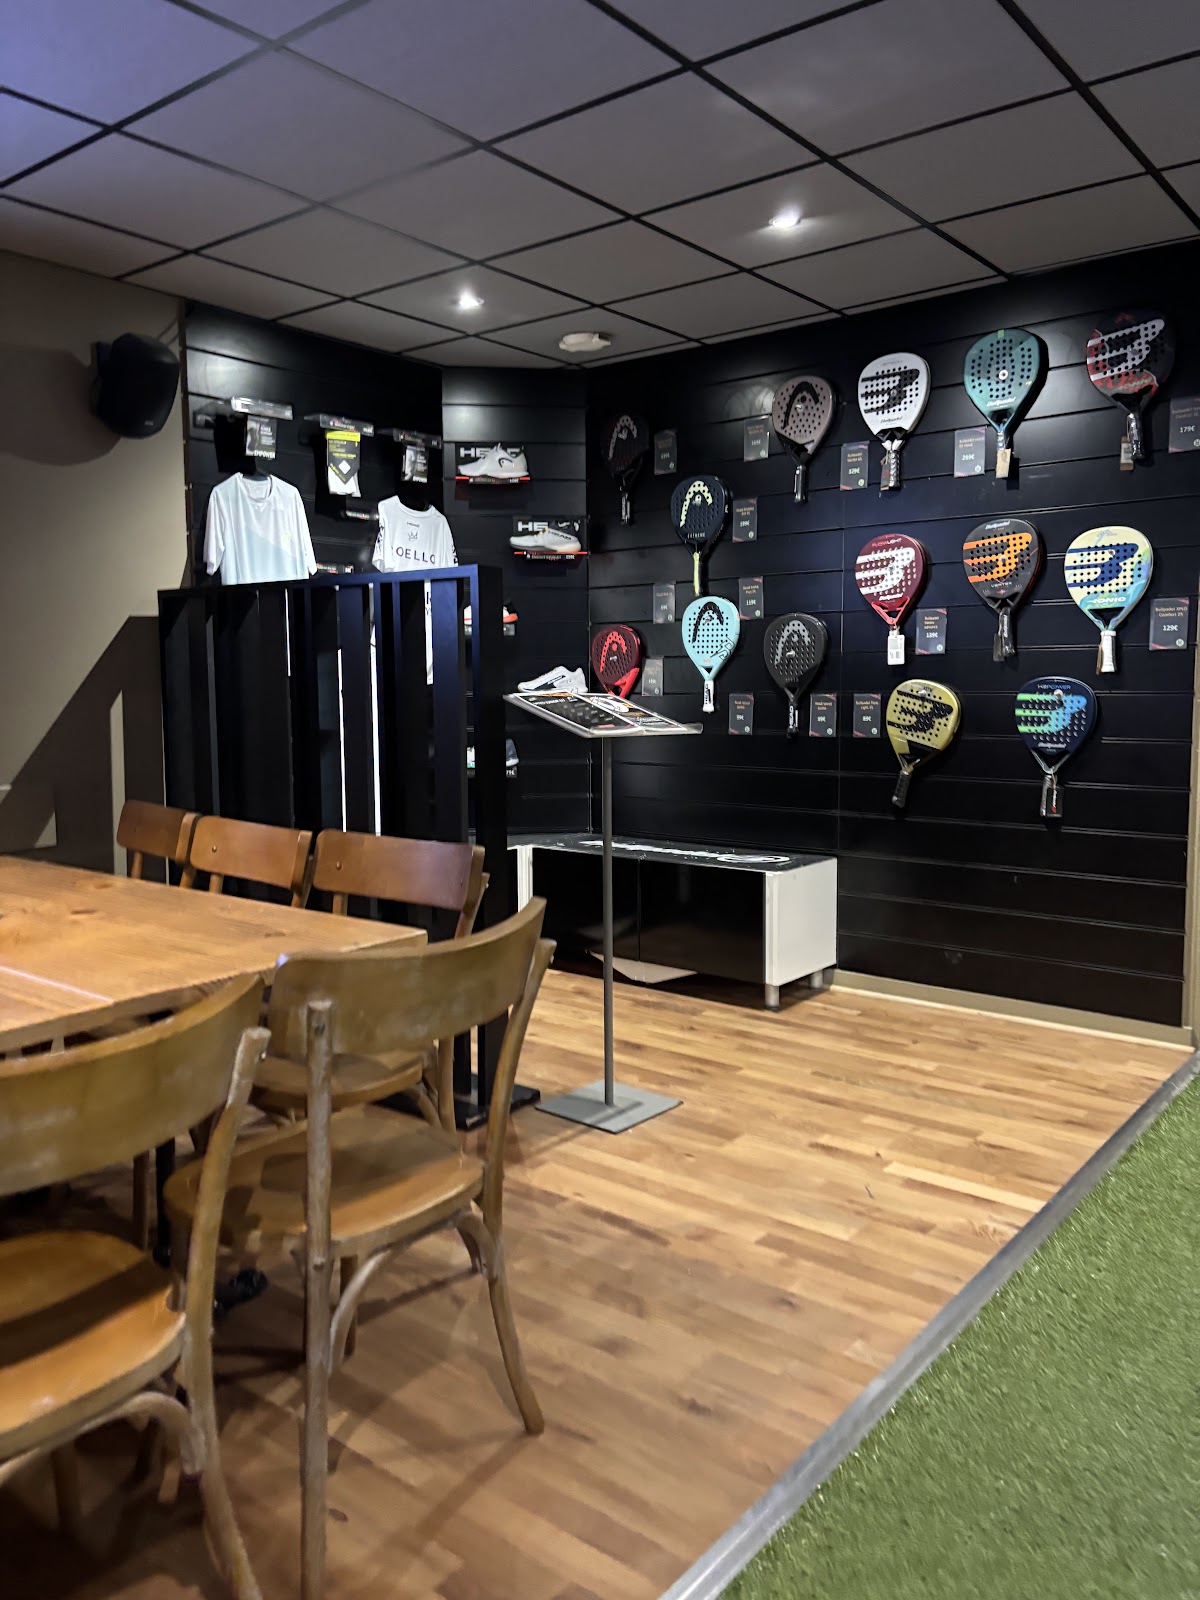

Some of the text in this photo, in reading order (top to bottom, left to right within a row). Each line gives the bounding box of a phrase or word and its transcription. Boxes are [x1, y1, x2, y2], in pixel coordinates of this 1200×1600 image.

[1179, 425, 1195, 433] 179€
[459, 446, 521, 459] HED
[391, 546, 436, 565] OELLO
